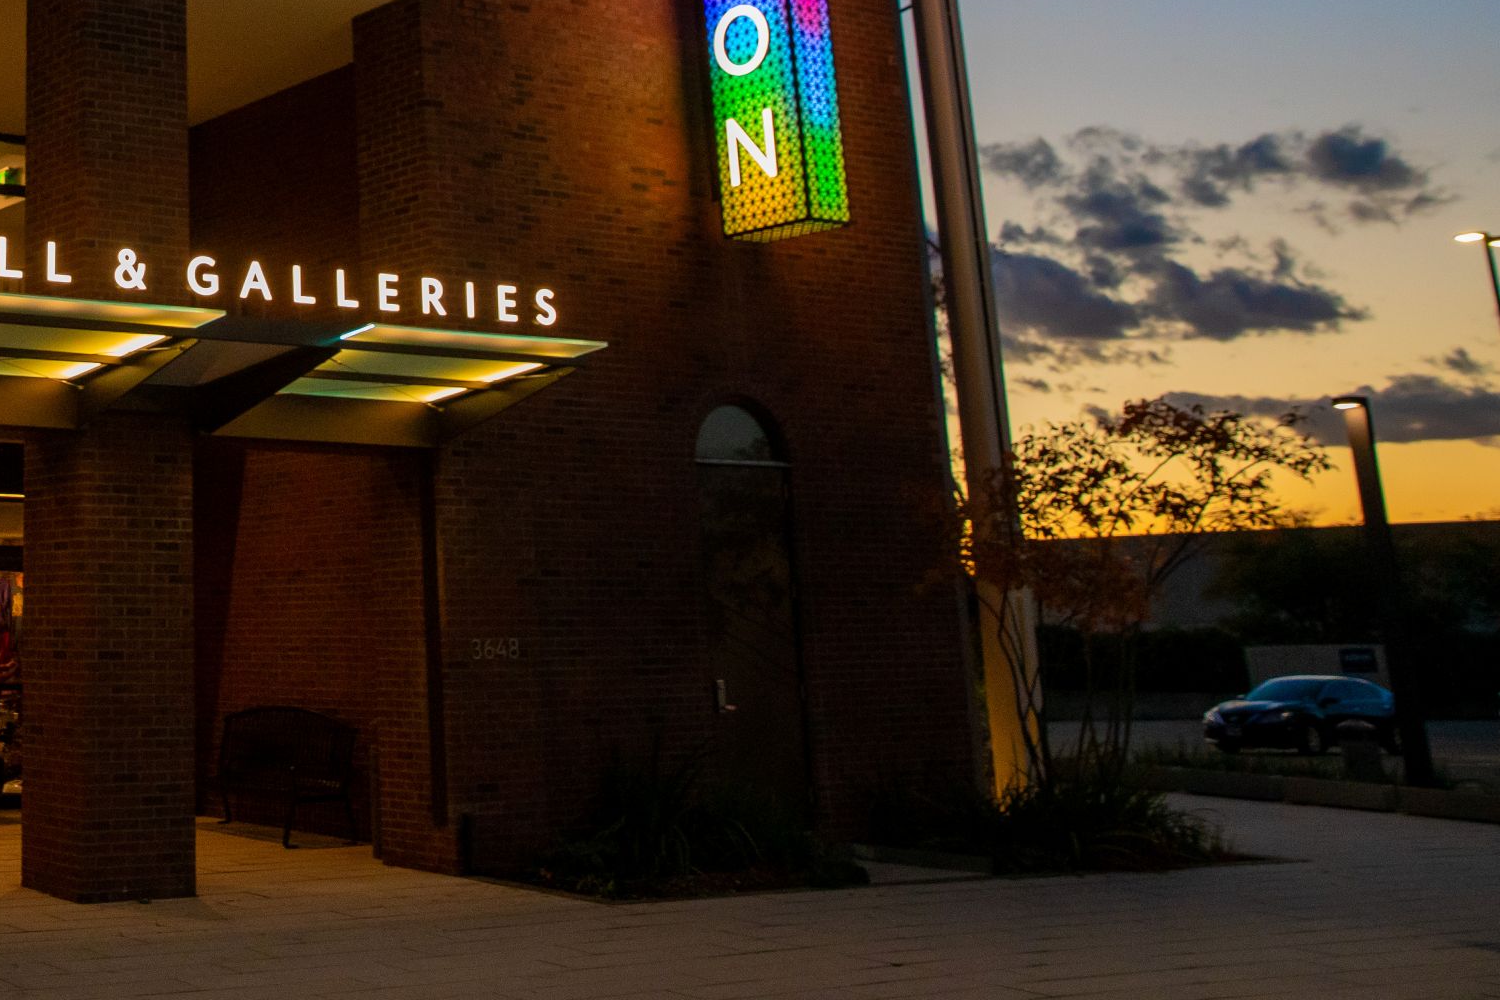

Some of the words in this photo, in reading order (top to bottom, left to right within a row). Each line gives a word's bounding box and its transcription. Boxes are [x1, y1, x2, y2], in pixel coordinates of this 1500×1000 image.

[113, 248, 148, 291] &
[186, 255, 558, 326] GALLERIES
[470, 638, 520, 660] 3648
